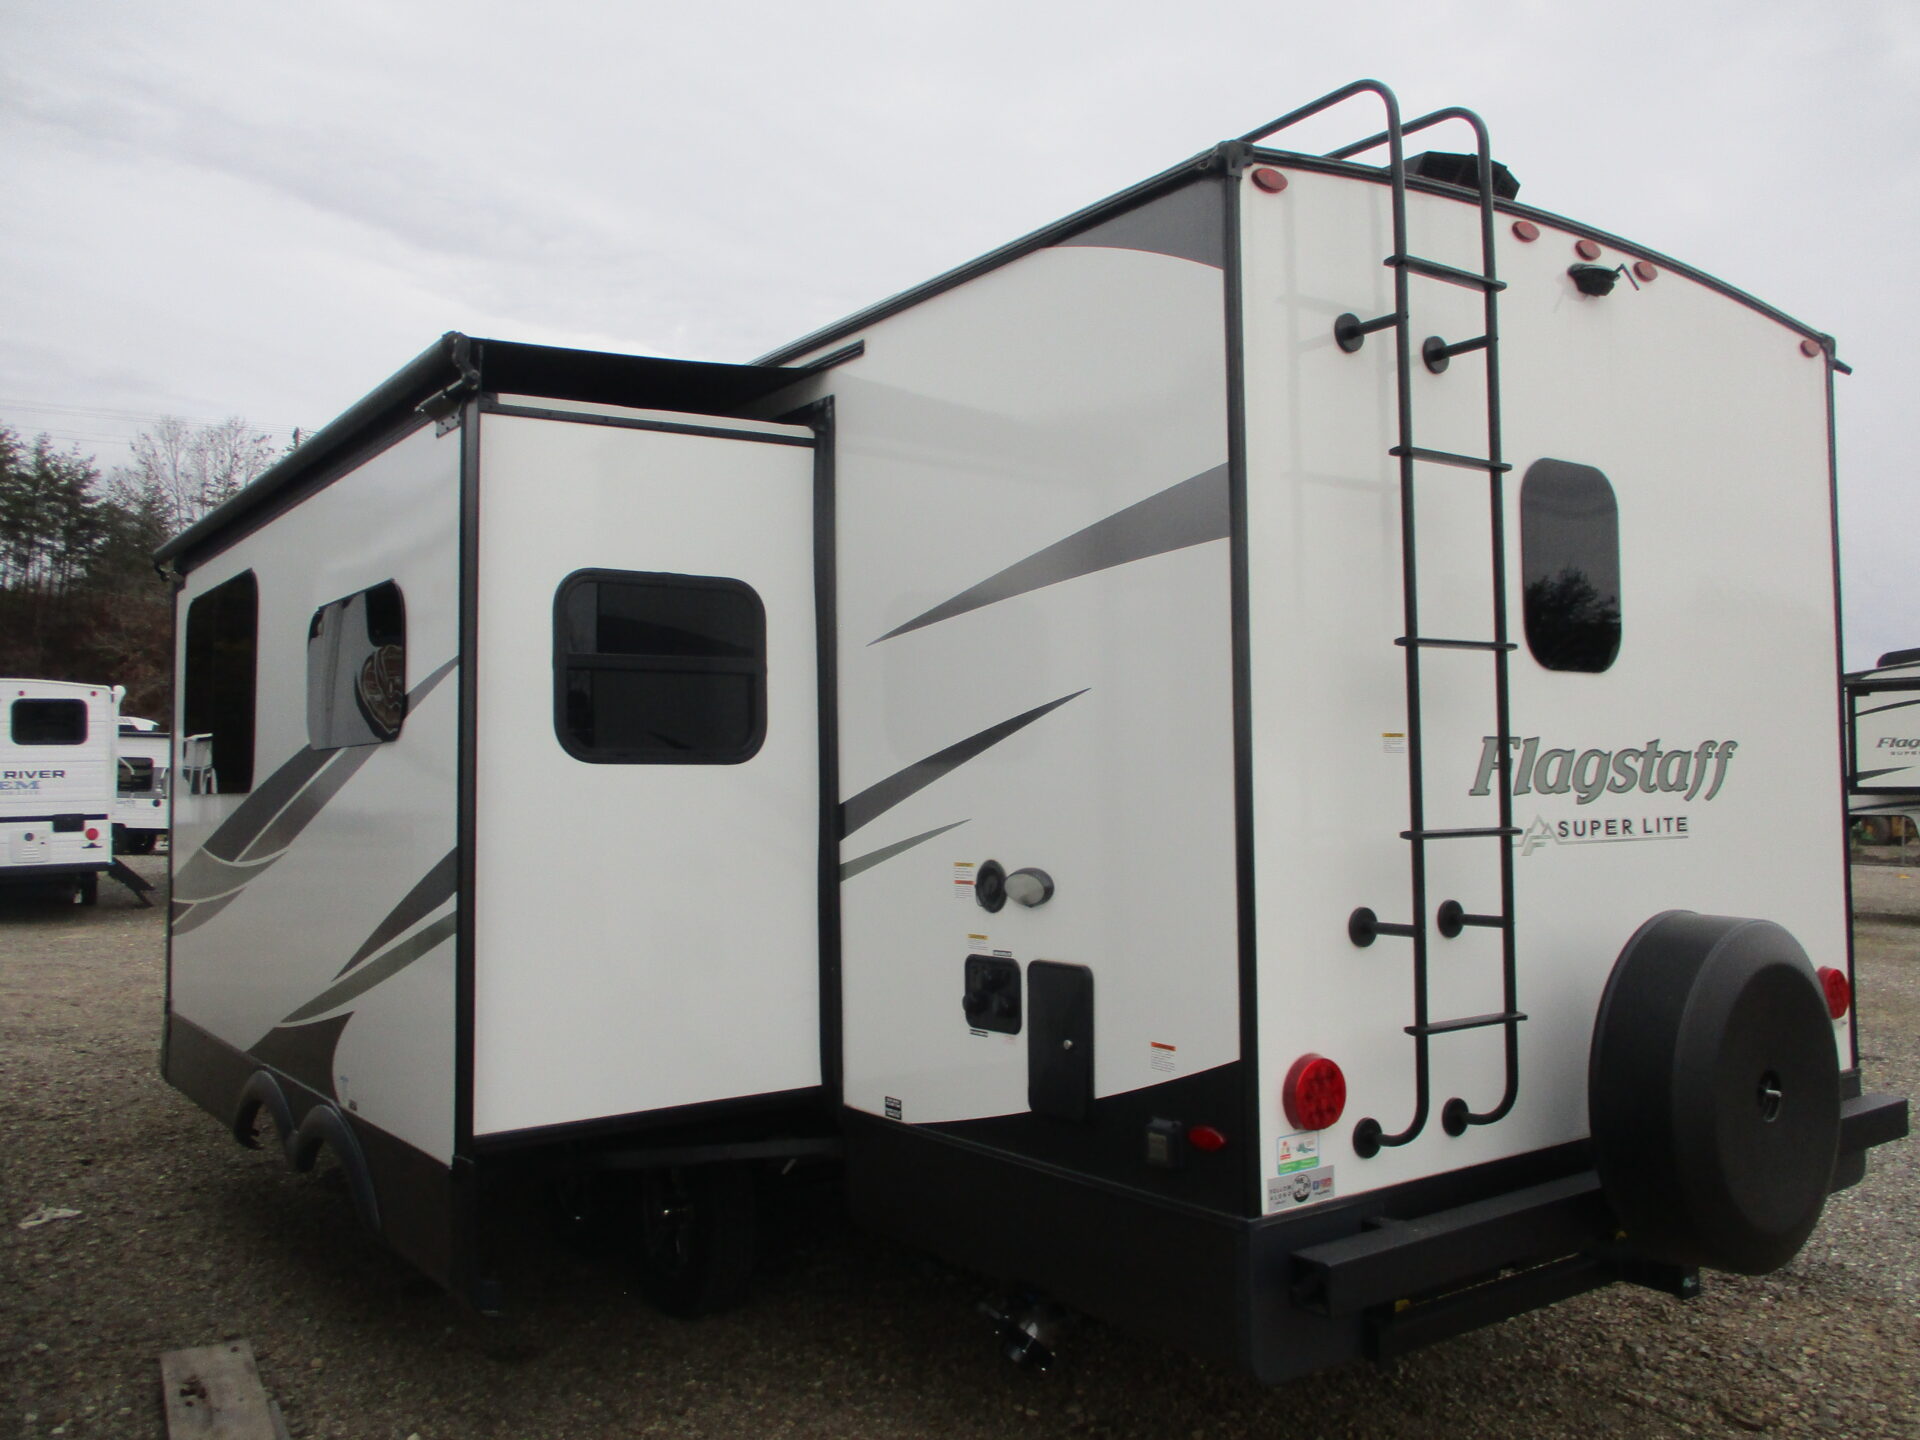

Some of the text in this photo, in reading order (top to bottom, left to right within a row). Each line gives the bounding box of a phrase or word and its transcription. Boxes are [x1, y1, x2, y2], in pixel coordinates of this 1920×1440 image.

[4, 770, 65, 779] RIVER
[1468, 735, 1739, 805] Flagstaff
[1557, 816, 1689, 838] SUPER LITE
